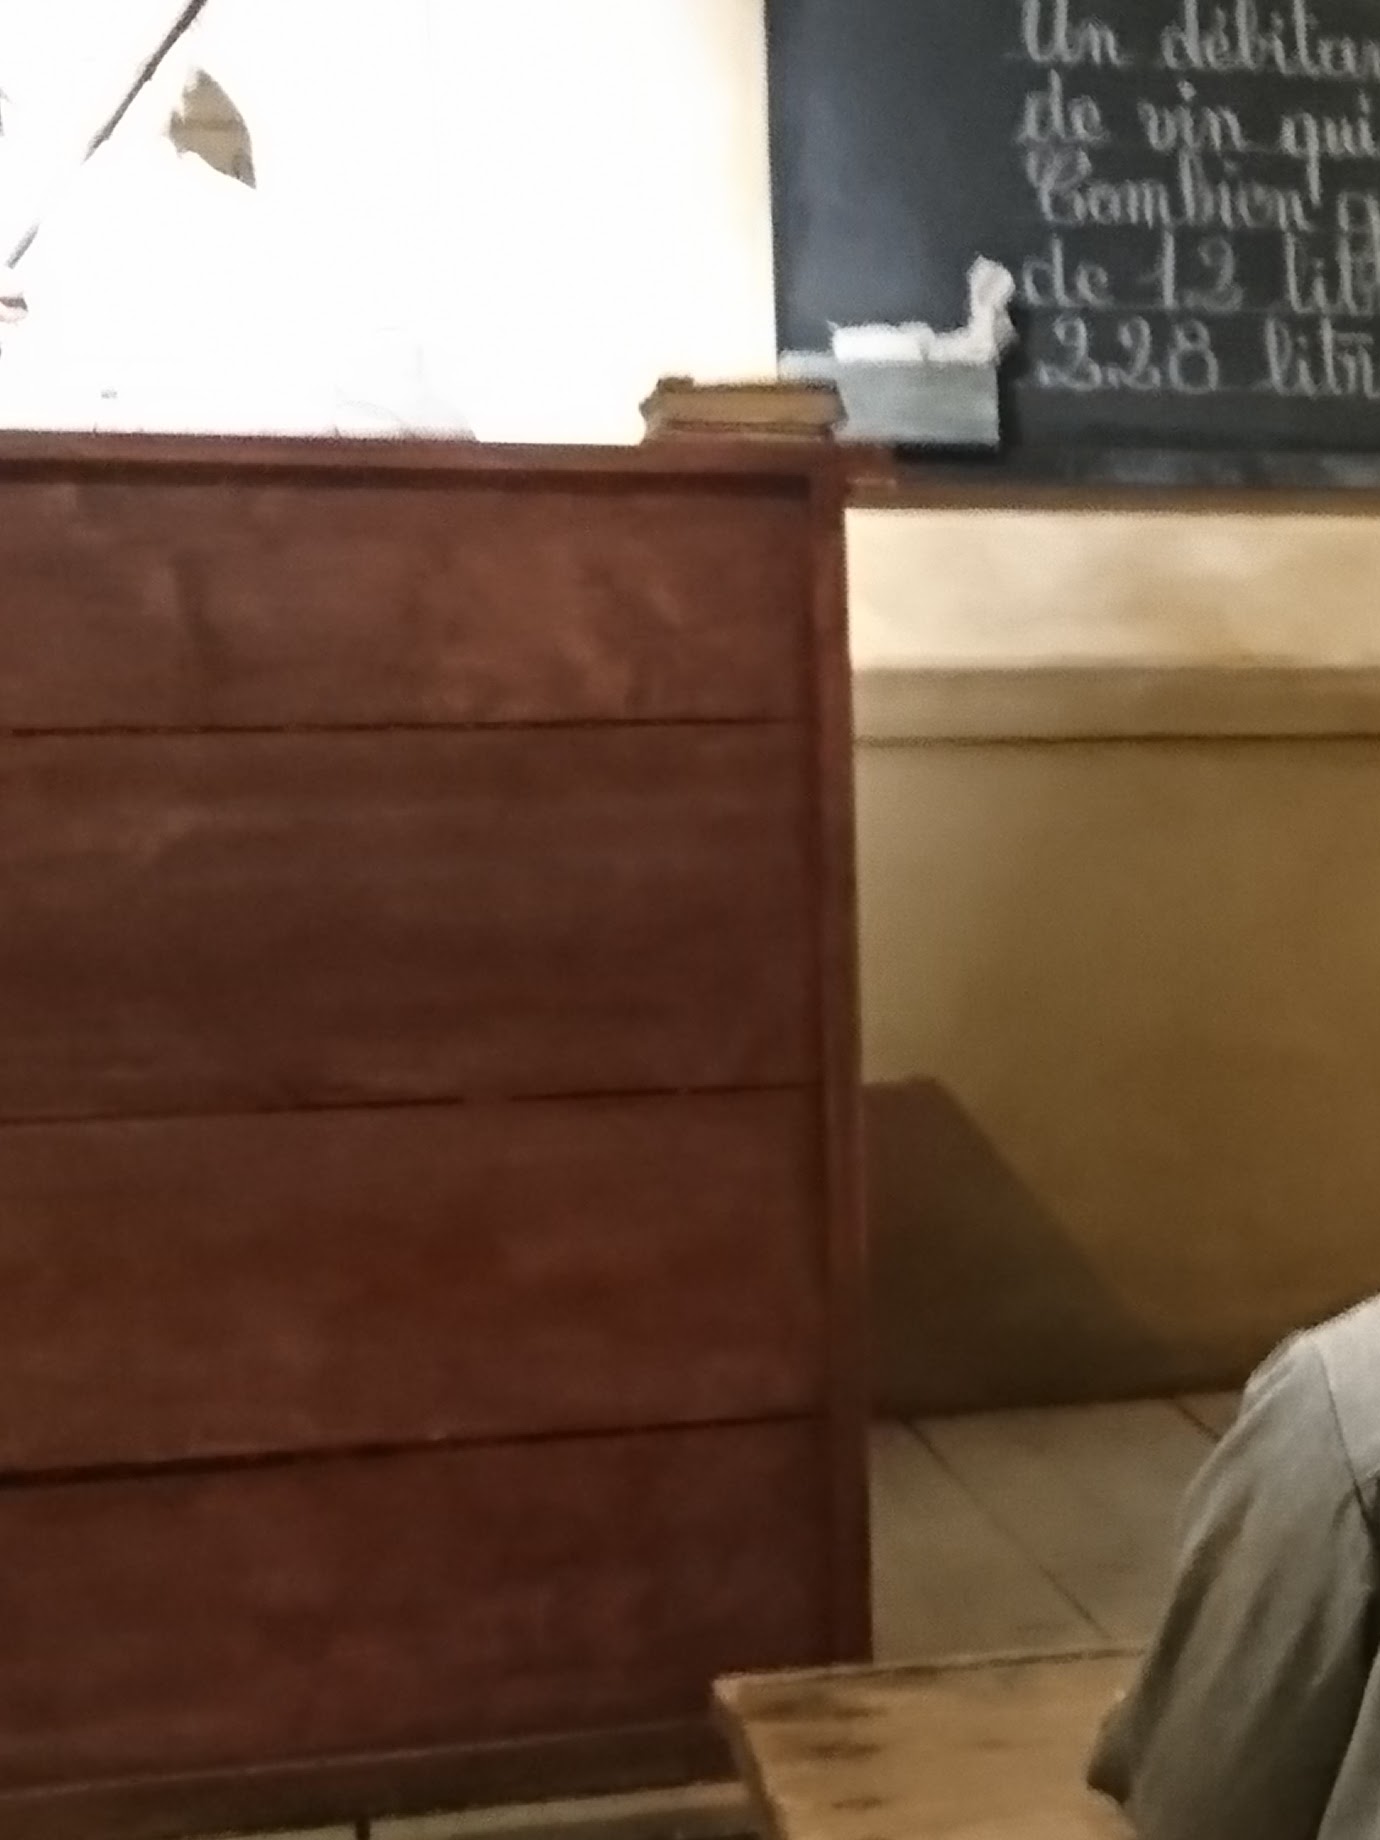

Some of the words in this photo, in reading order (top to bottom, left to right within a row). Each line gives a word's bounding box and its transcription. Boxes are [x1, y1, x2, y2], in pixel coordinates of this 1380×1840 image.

[1021, 68, 1106, 146] de
[1138, 79, 1250, 154] vin
[1281, 88, 1380, 207] qui
[1026, 149, 1315, 230] Combien
[1021, 234, 1109, 308] de
[1145, 231, 1244, 312] 12
[1037, 314, 1220, 396] 228
